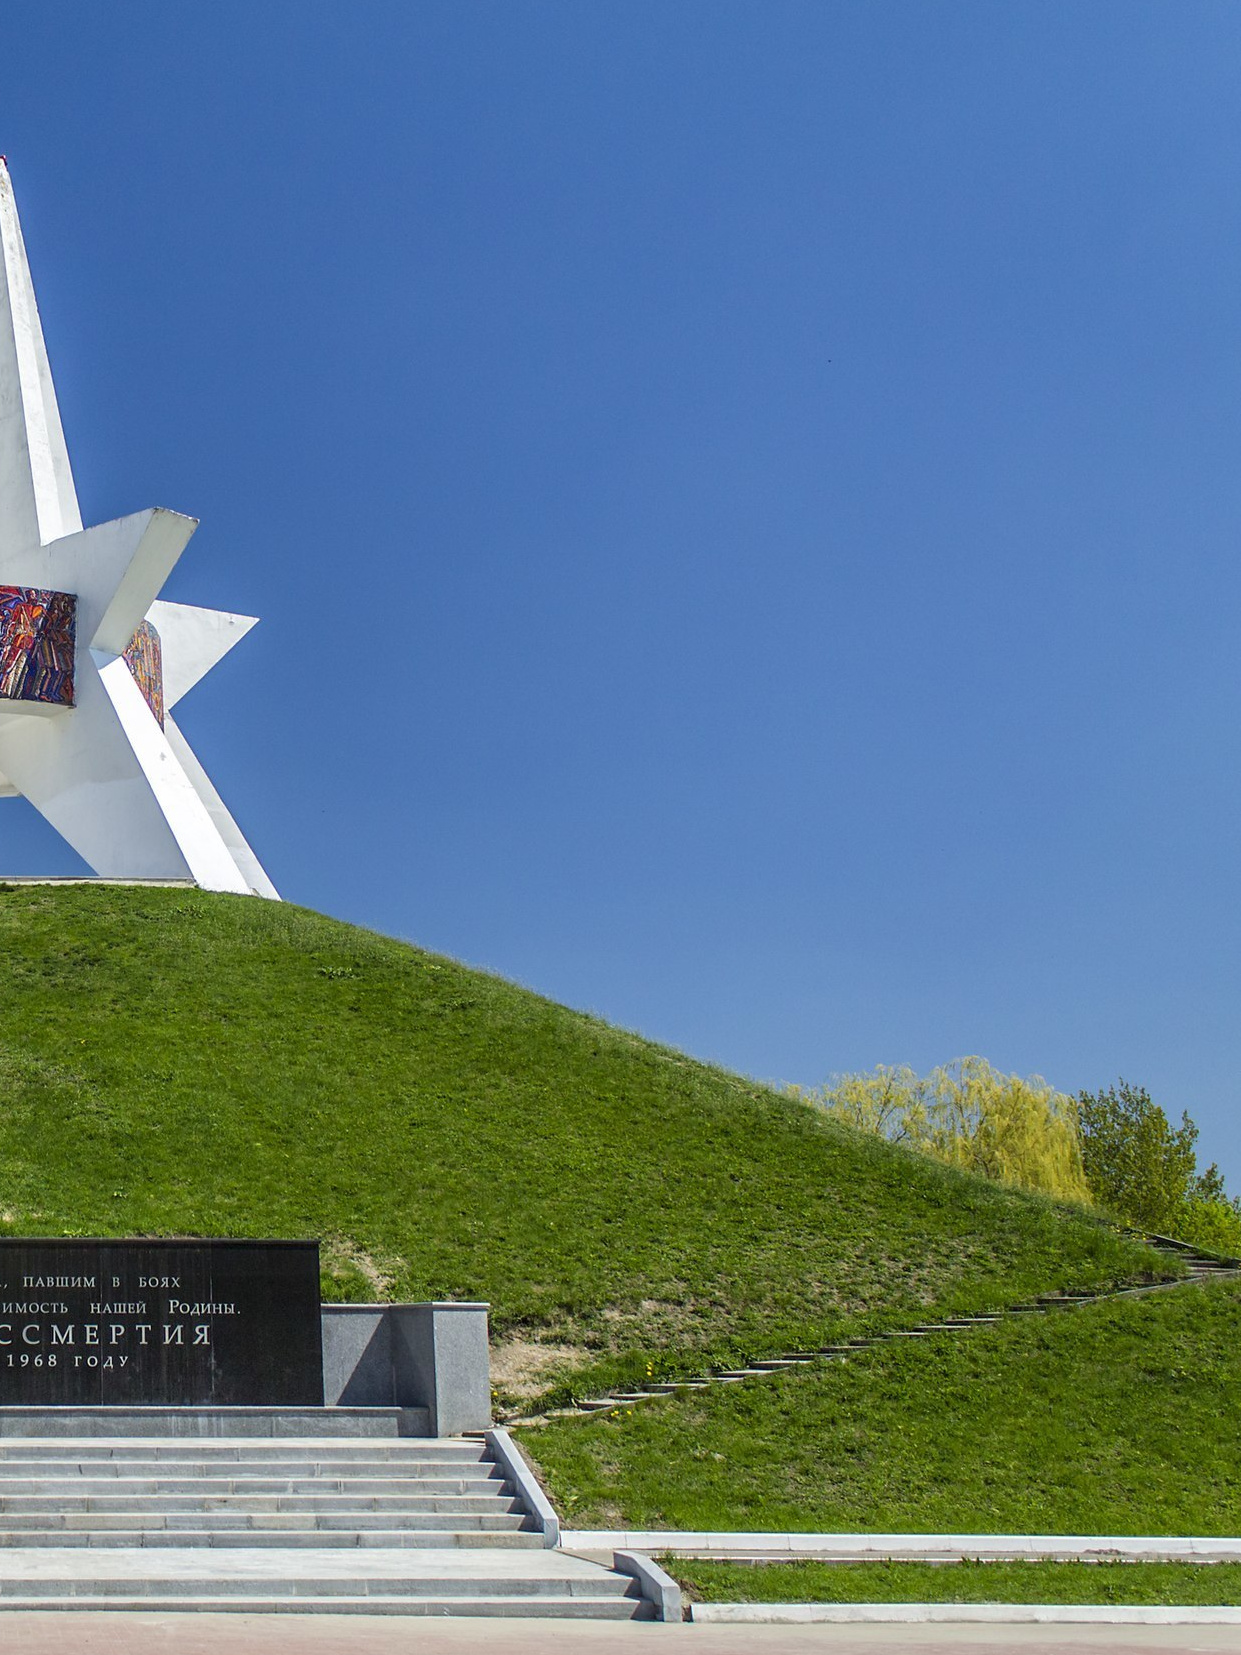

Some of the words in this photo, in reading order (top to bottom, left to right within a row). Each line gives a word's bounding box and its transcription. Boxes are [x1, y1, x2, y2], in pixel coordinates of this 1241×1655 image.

[23, 1276, 96, 1288] ПАВШИМ
[111, 1276, 121, 1288] В
[138, 1276, 181, 1288] БОЯХ
[89, 1300, 147, 1314] НАШЕЙ
[6, 1353, 58, 1367] 1968
[73, 1355, 129, 1369] ГОДУ
